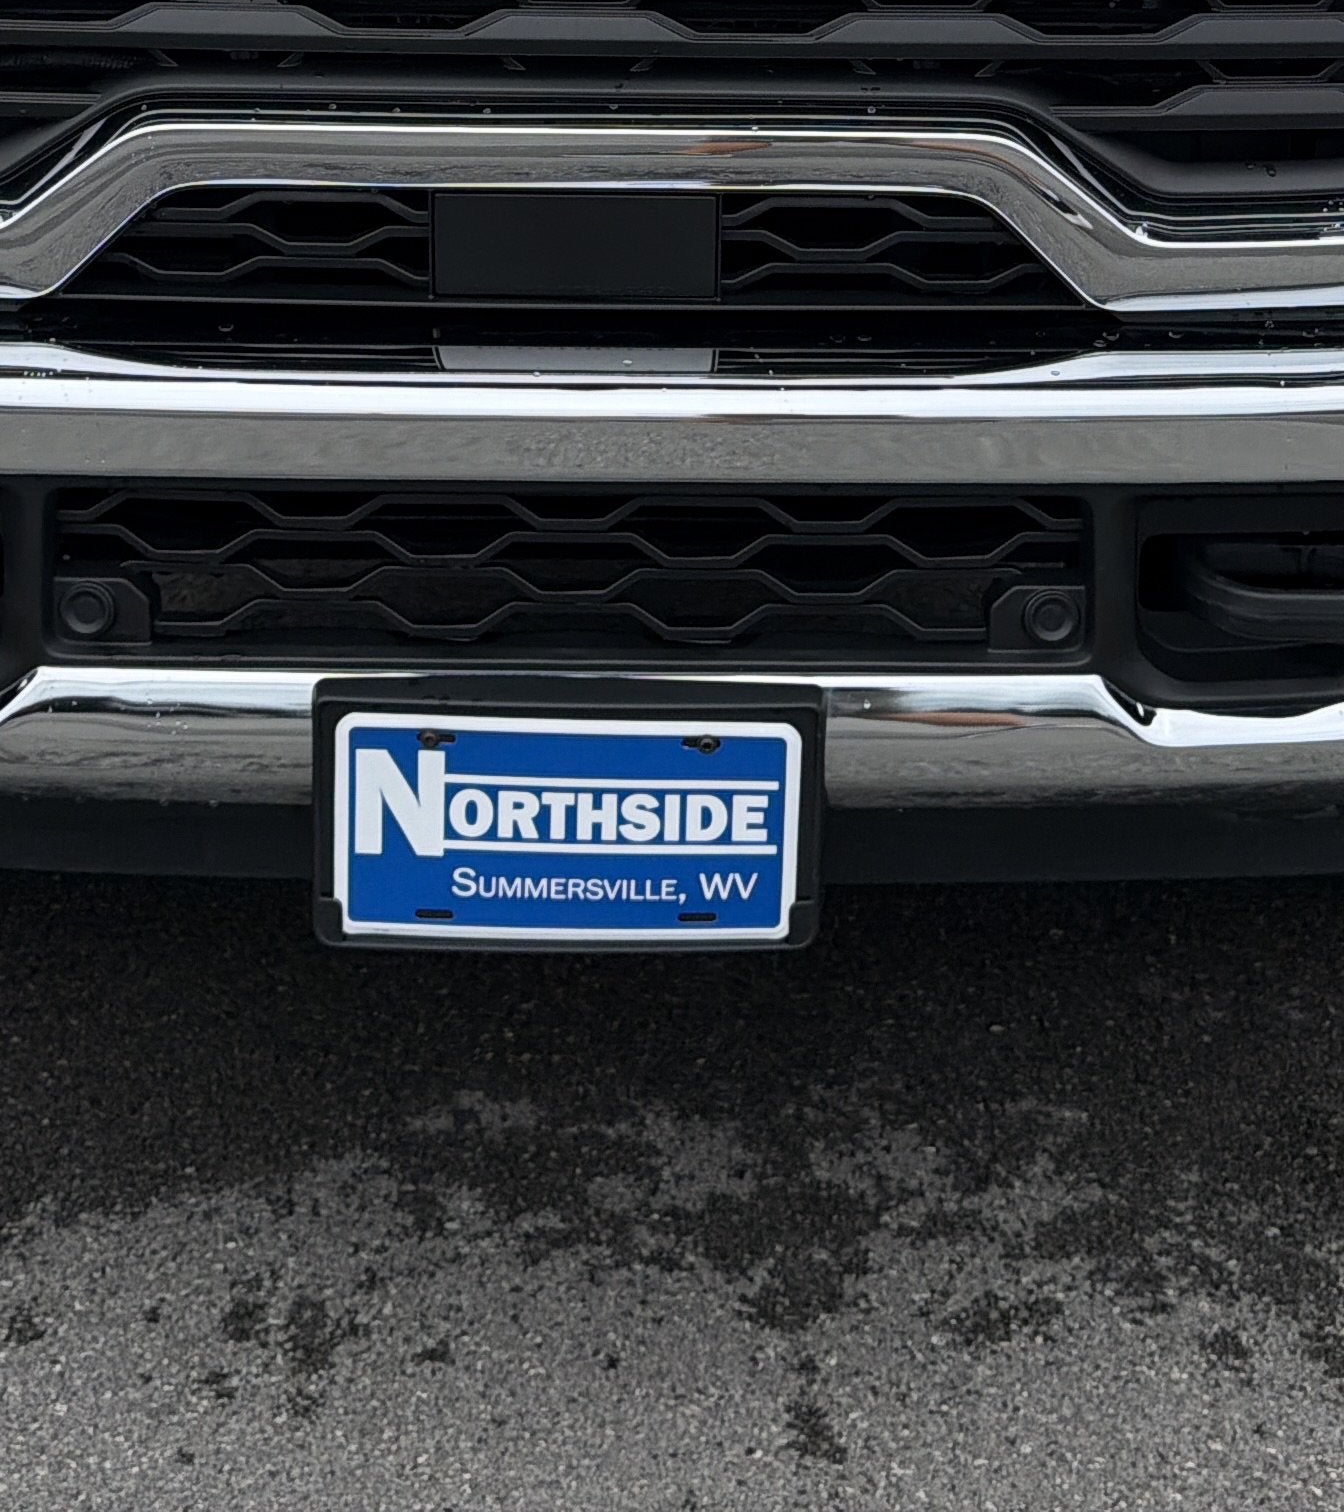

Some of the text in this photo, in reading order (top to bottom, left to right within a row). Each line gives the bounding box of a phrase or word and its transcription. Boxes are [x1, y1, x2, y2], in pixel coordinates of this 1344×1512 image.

[355, 748, 769, 857] NORTHSIDE
[451, 867, 758, 905] SUMMERSVILLE, WV
